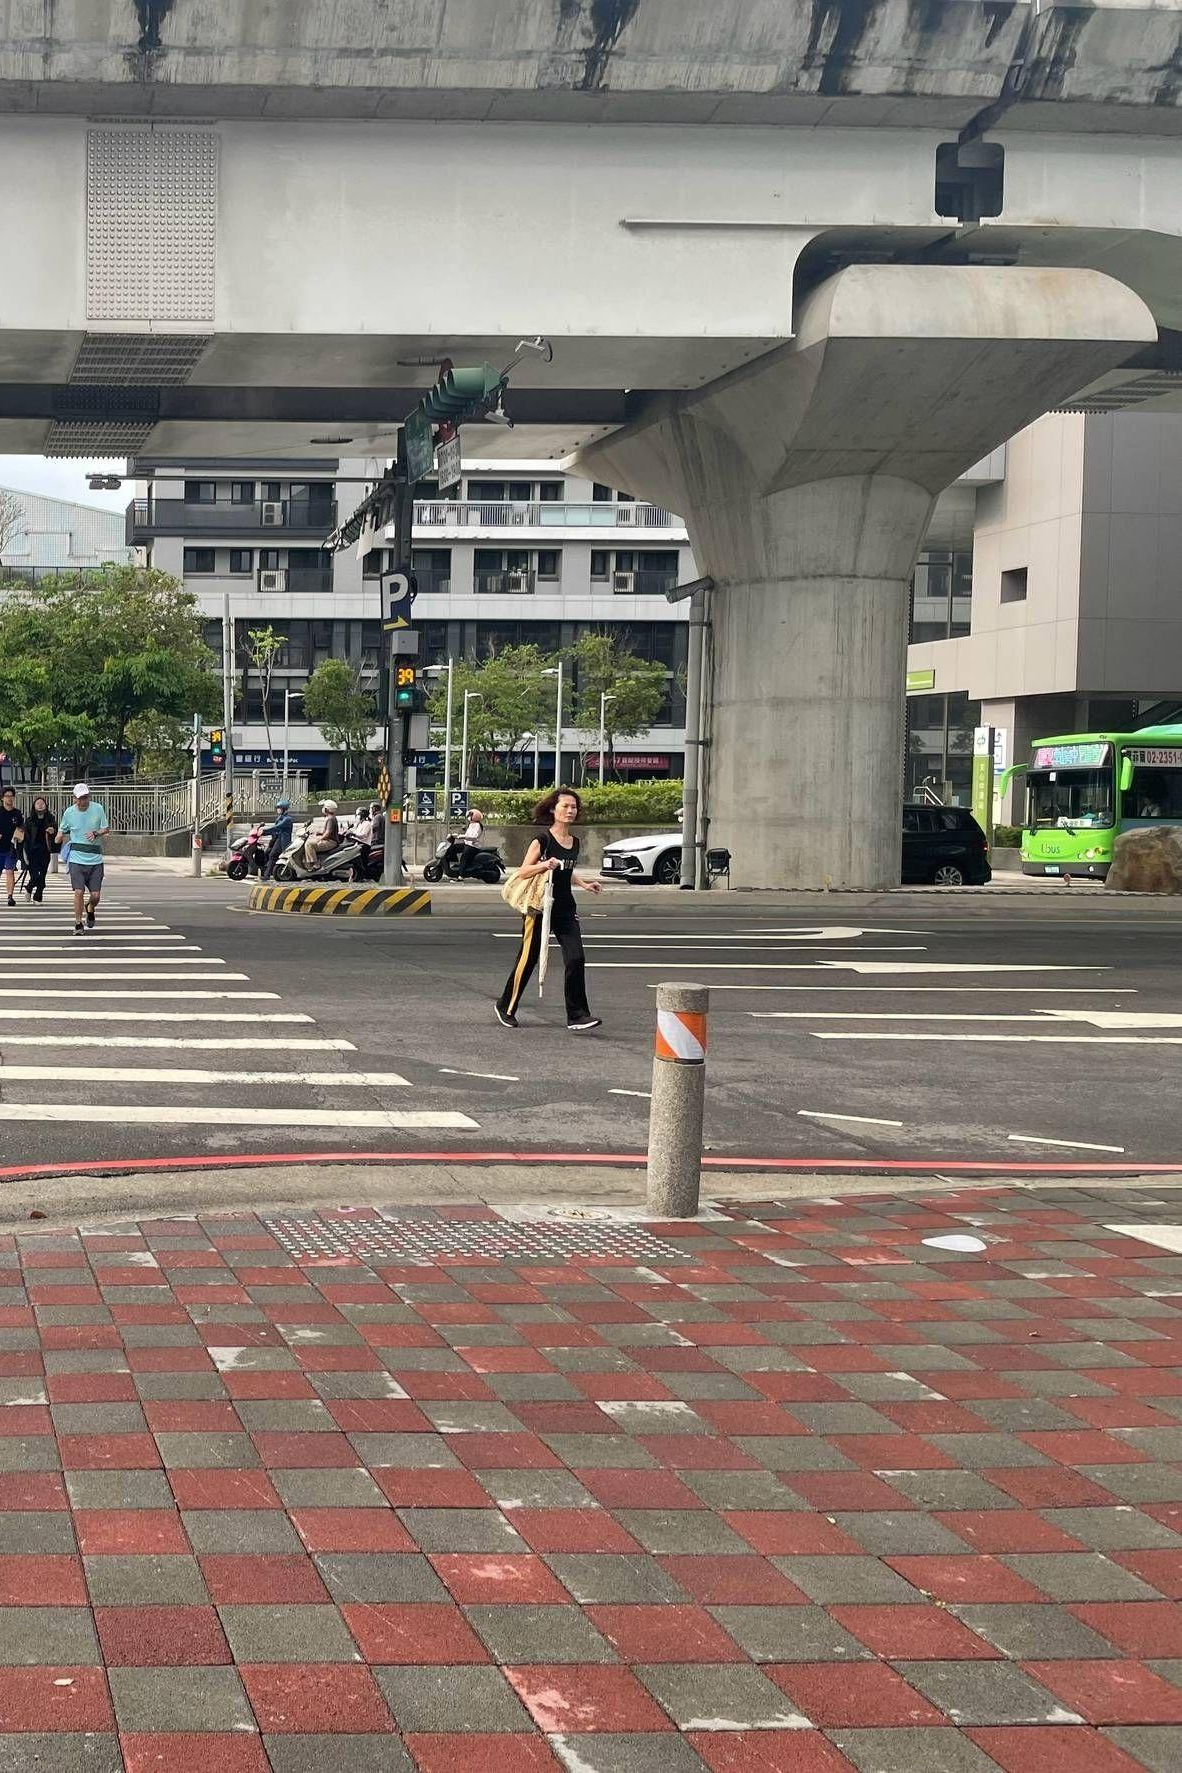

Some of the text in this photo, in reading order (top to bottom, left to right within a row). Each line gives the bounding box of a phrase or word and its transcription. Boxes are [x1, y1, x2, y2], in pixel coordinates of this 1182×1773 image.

[381, 573, 409, 620] P
[398, 668, 414, 685] 39
[451, 793, 462, 804] P
